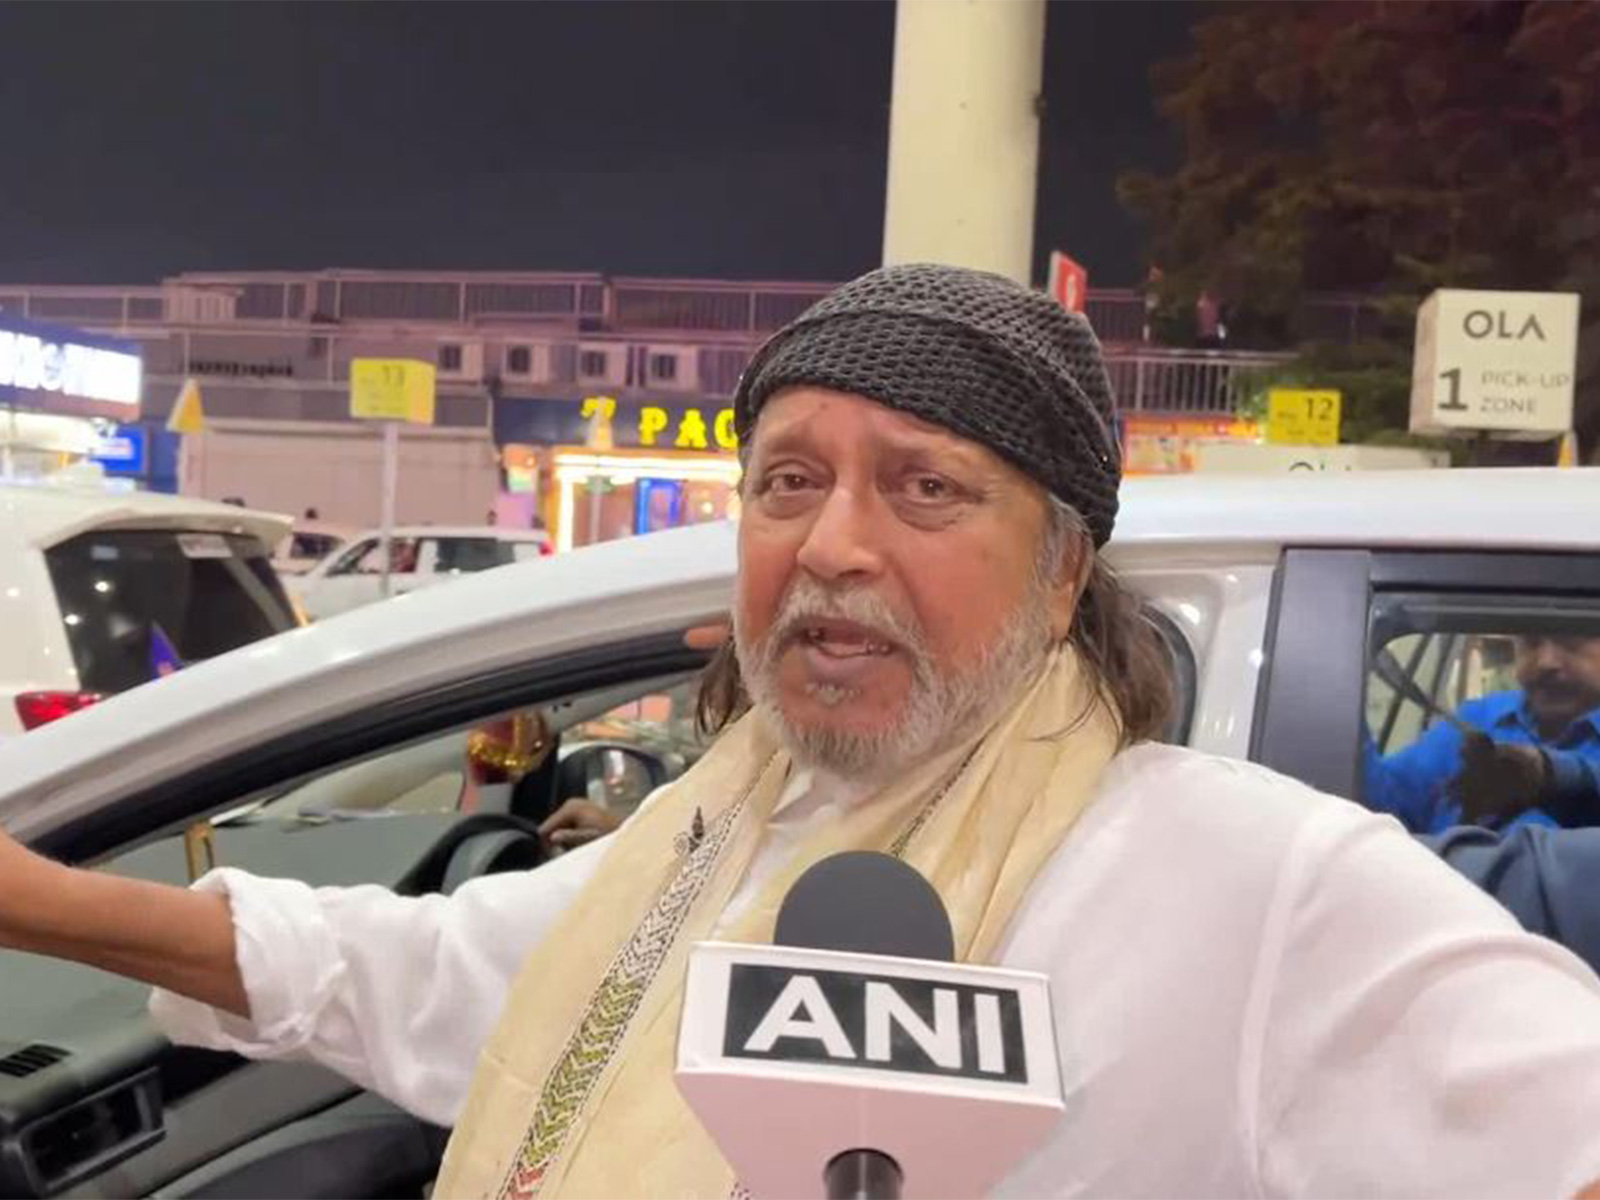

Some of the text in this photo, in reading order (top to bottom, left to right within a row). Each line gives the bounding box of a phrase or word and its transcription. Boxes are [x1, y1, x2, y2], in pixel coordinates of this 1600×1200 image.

[1463, 310, 1546, 341] OLA
[1437, 367, 1468, 411] 1
[1480, 370, 1569, 389] PICK-UP
[1304, 397, 1334, 420] 12
[1480, 397, 1538, 414] ZONE
[743, 974, 1006, 1074] ANI
